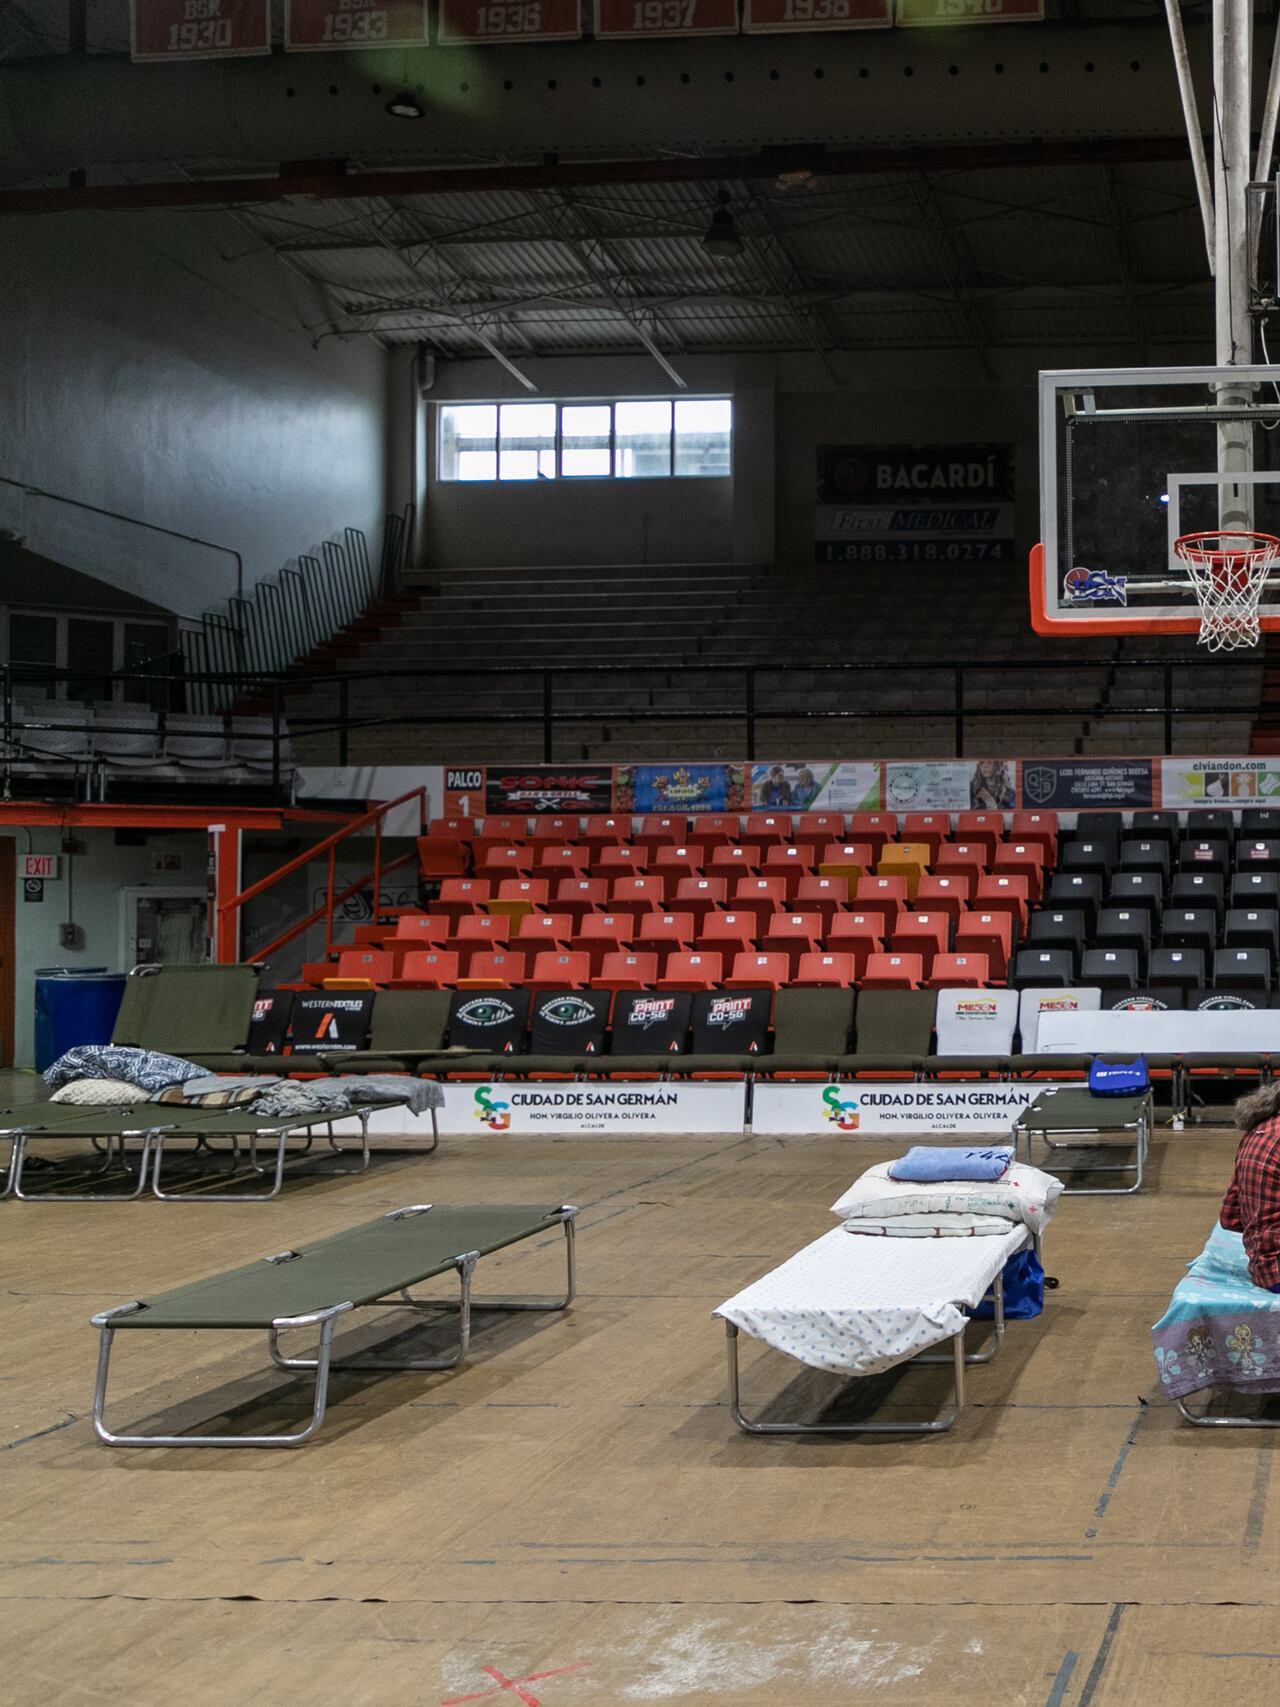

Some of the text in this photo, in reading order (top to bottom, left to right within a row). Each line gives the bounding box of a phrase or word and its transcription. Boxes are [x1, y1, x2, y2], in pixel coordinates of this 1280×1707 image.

[477, 3, 541, 34] 1936
[632, 0, 697, 30] 1937
[167, 18, 232, 50] 1930
[322, 11, 388, 41] 1933
[876, 455, 995, 488] BACARDÍ
[837, 511, 993, 530] First MEDICAL
[826, 544, 1003, 561] 1.888.318.0274
[1193, 762, 1266, 771] elviandon.com
[447, 771, 482, 788] PALCO
[499, 775, 600, 790] SONIC
[458, 795, 470, 817] 1
[25, 858, 52, 875] EXIT
[511, 1089, 678, 1106] CIUDAD DE SAN GERMÁN
[860, 1088, 1029, 1106] CIUDAD DE SAN GERMÁN
